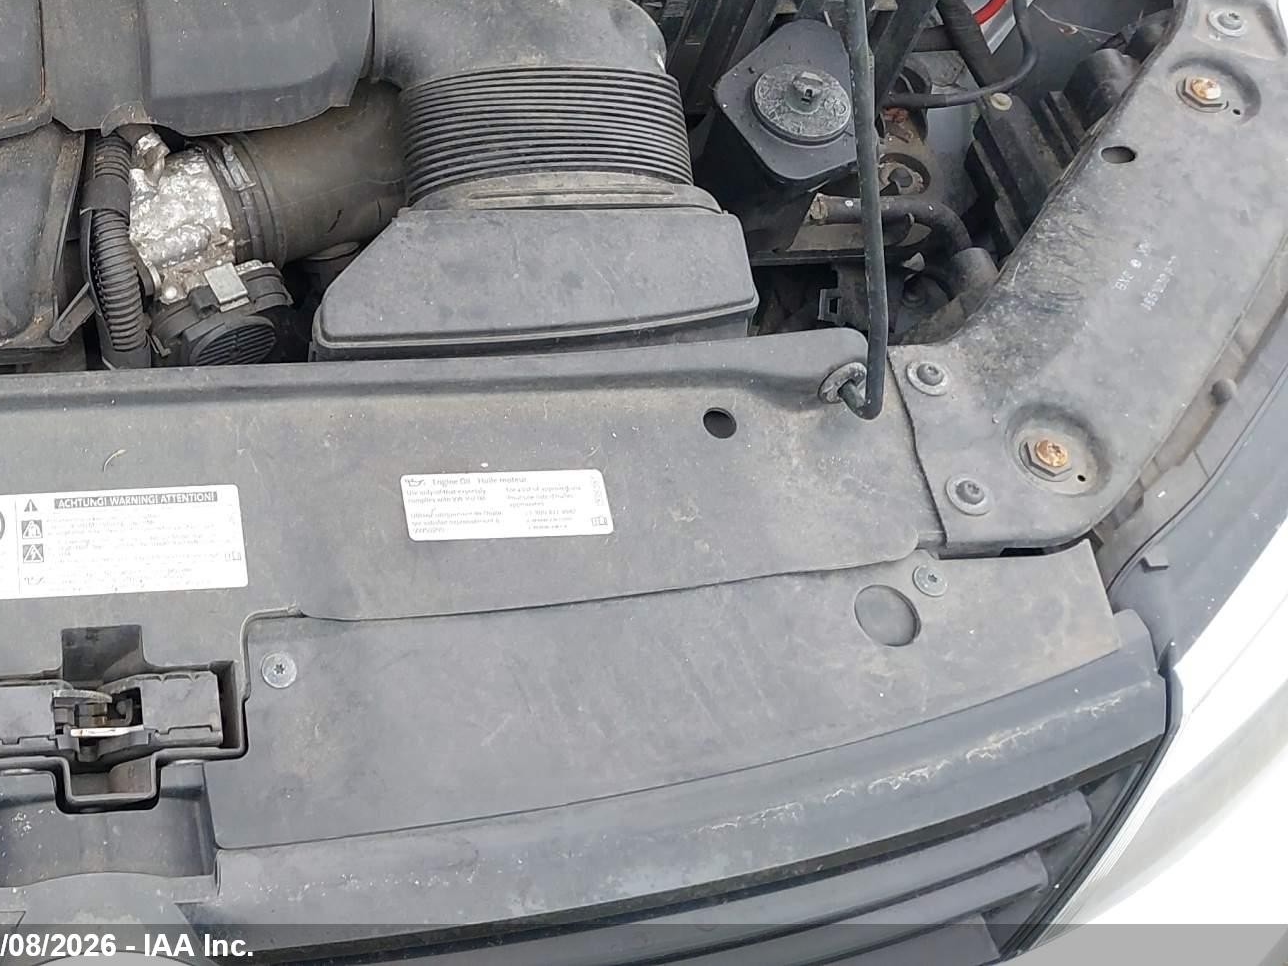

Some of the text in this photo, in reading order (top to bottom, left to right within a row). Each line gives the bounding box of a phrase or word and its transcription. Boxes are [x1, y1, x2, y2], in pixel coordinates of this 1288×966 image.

[57, 491, 215, 509] ACHTUNG! WARNING! ATTENTION!
